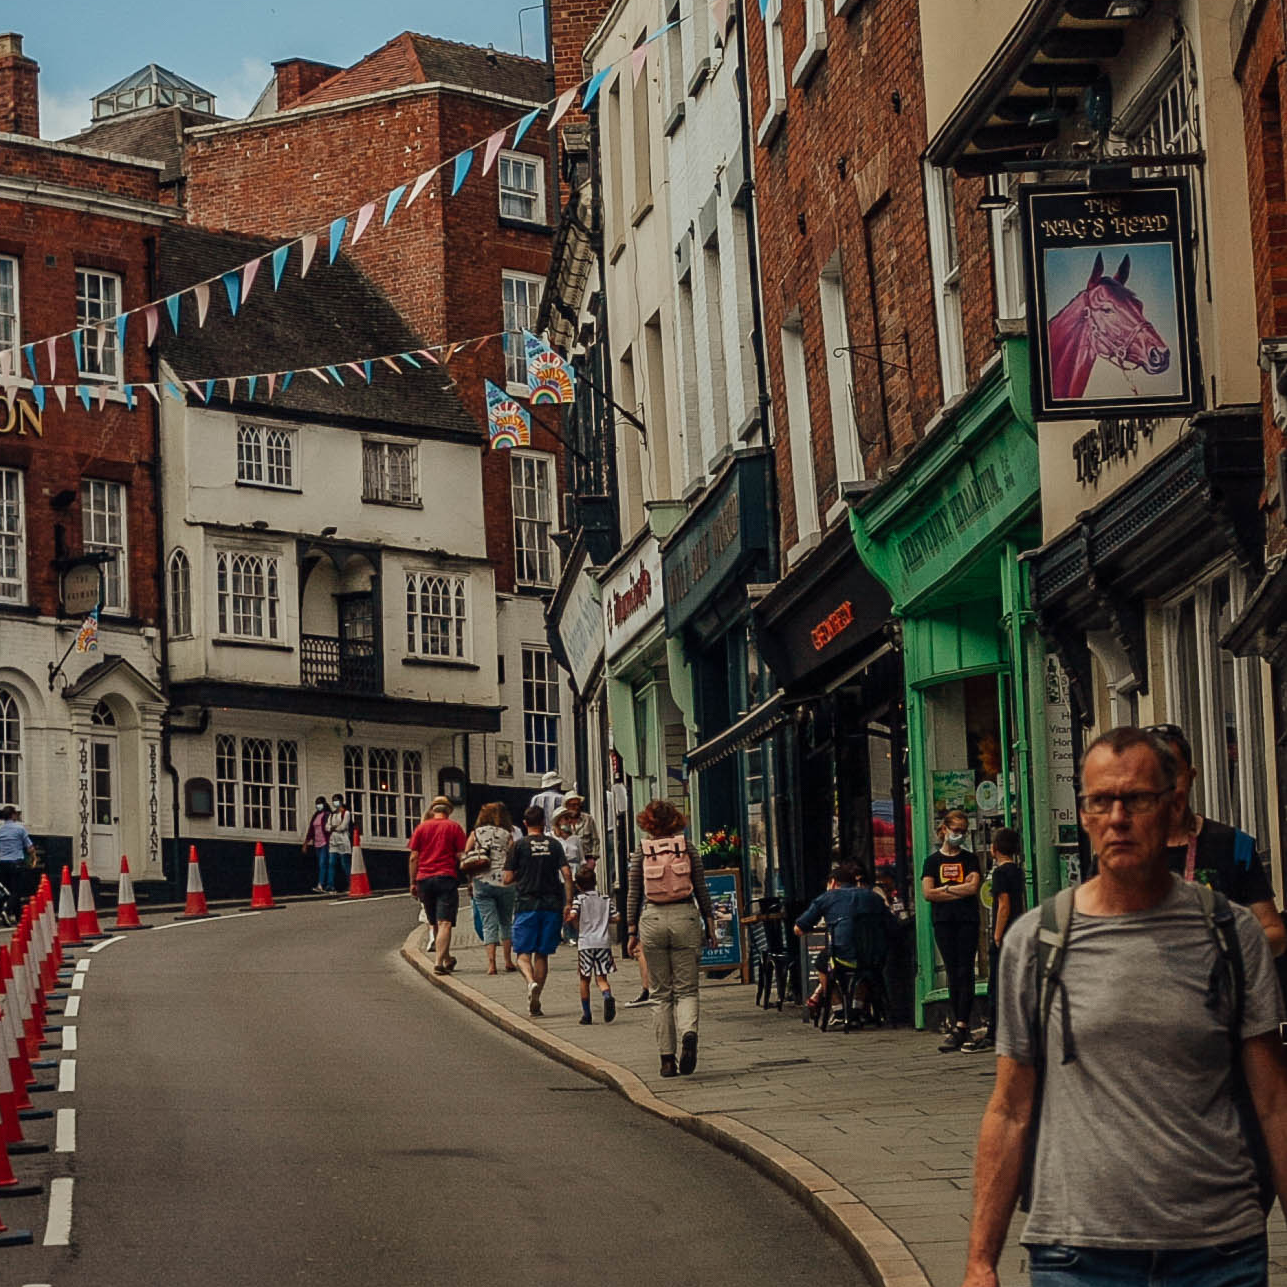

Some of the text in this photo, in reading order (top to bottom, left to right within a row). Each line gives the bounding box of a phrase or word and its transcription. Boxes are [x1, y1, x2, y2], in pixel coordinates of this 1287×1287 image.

[1041, 217, 1106, 239] NAG'S
[79, 738, 90, 858] THE HAYWARD
[149, 743, 159, 862] RESTAURANT
[1051, 808, 1073, 820] Tel:
